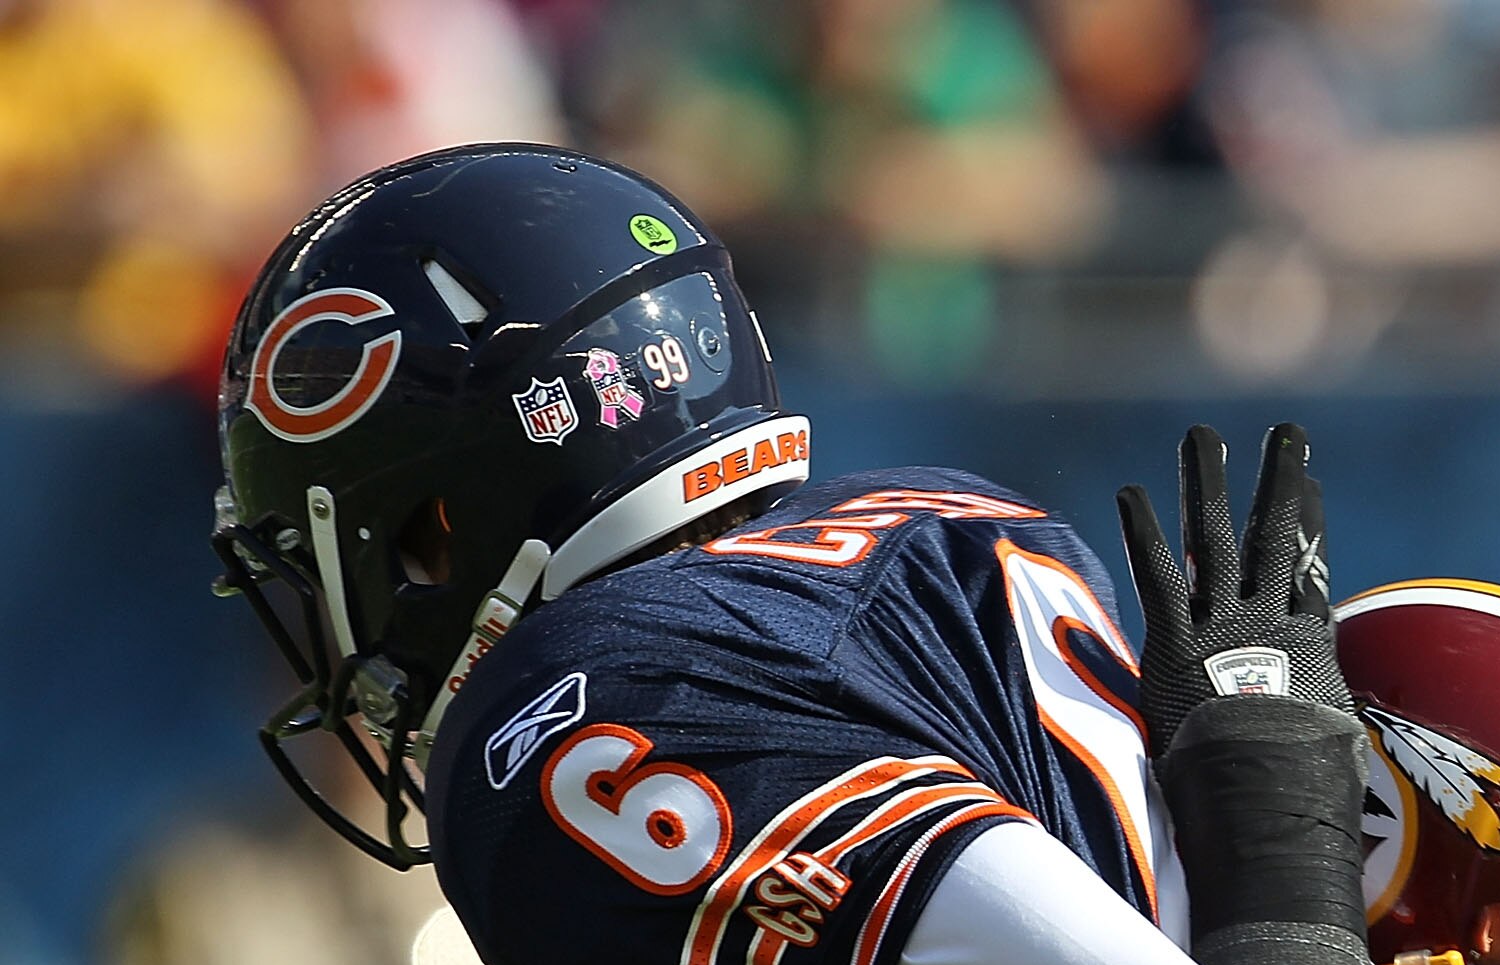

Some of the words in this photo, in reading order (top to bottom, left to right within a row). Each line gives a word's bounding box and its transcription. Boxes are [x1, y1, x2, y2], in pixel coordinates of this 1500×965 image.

[643, 336, 691, 390] 99
[528, 403, 571, 436] NFL
[601, 385, 627, 406] NFL
[682, 429, 808, 504] BEARS
[540, 722, 733, 896] 6
[742, 850, 854, 949] GSH
